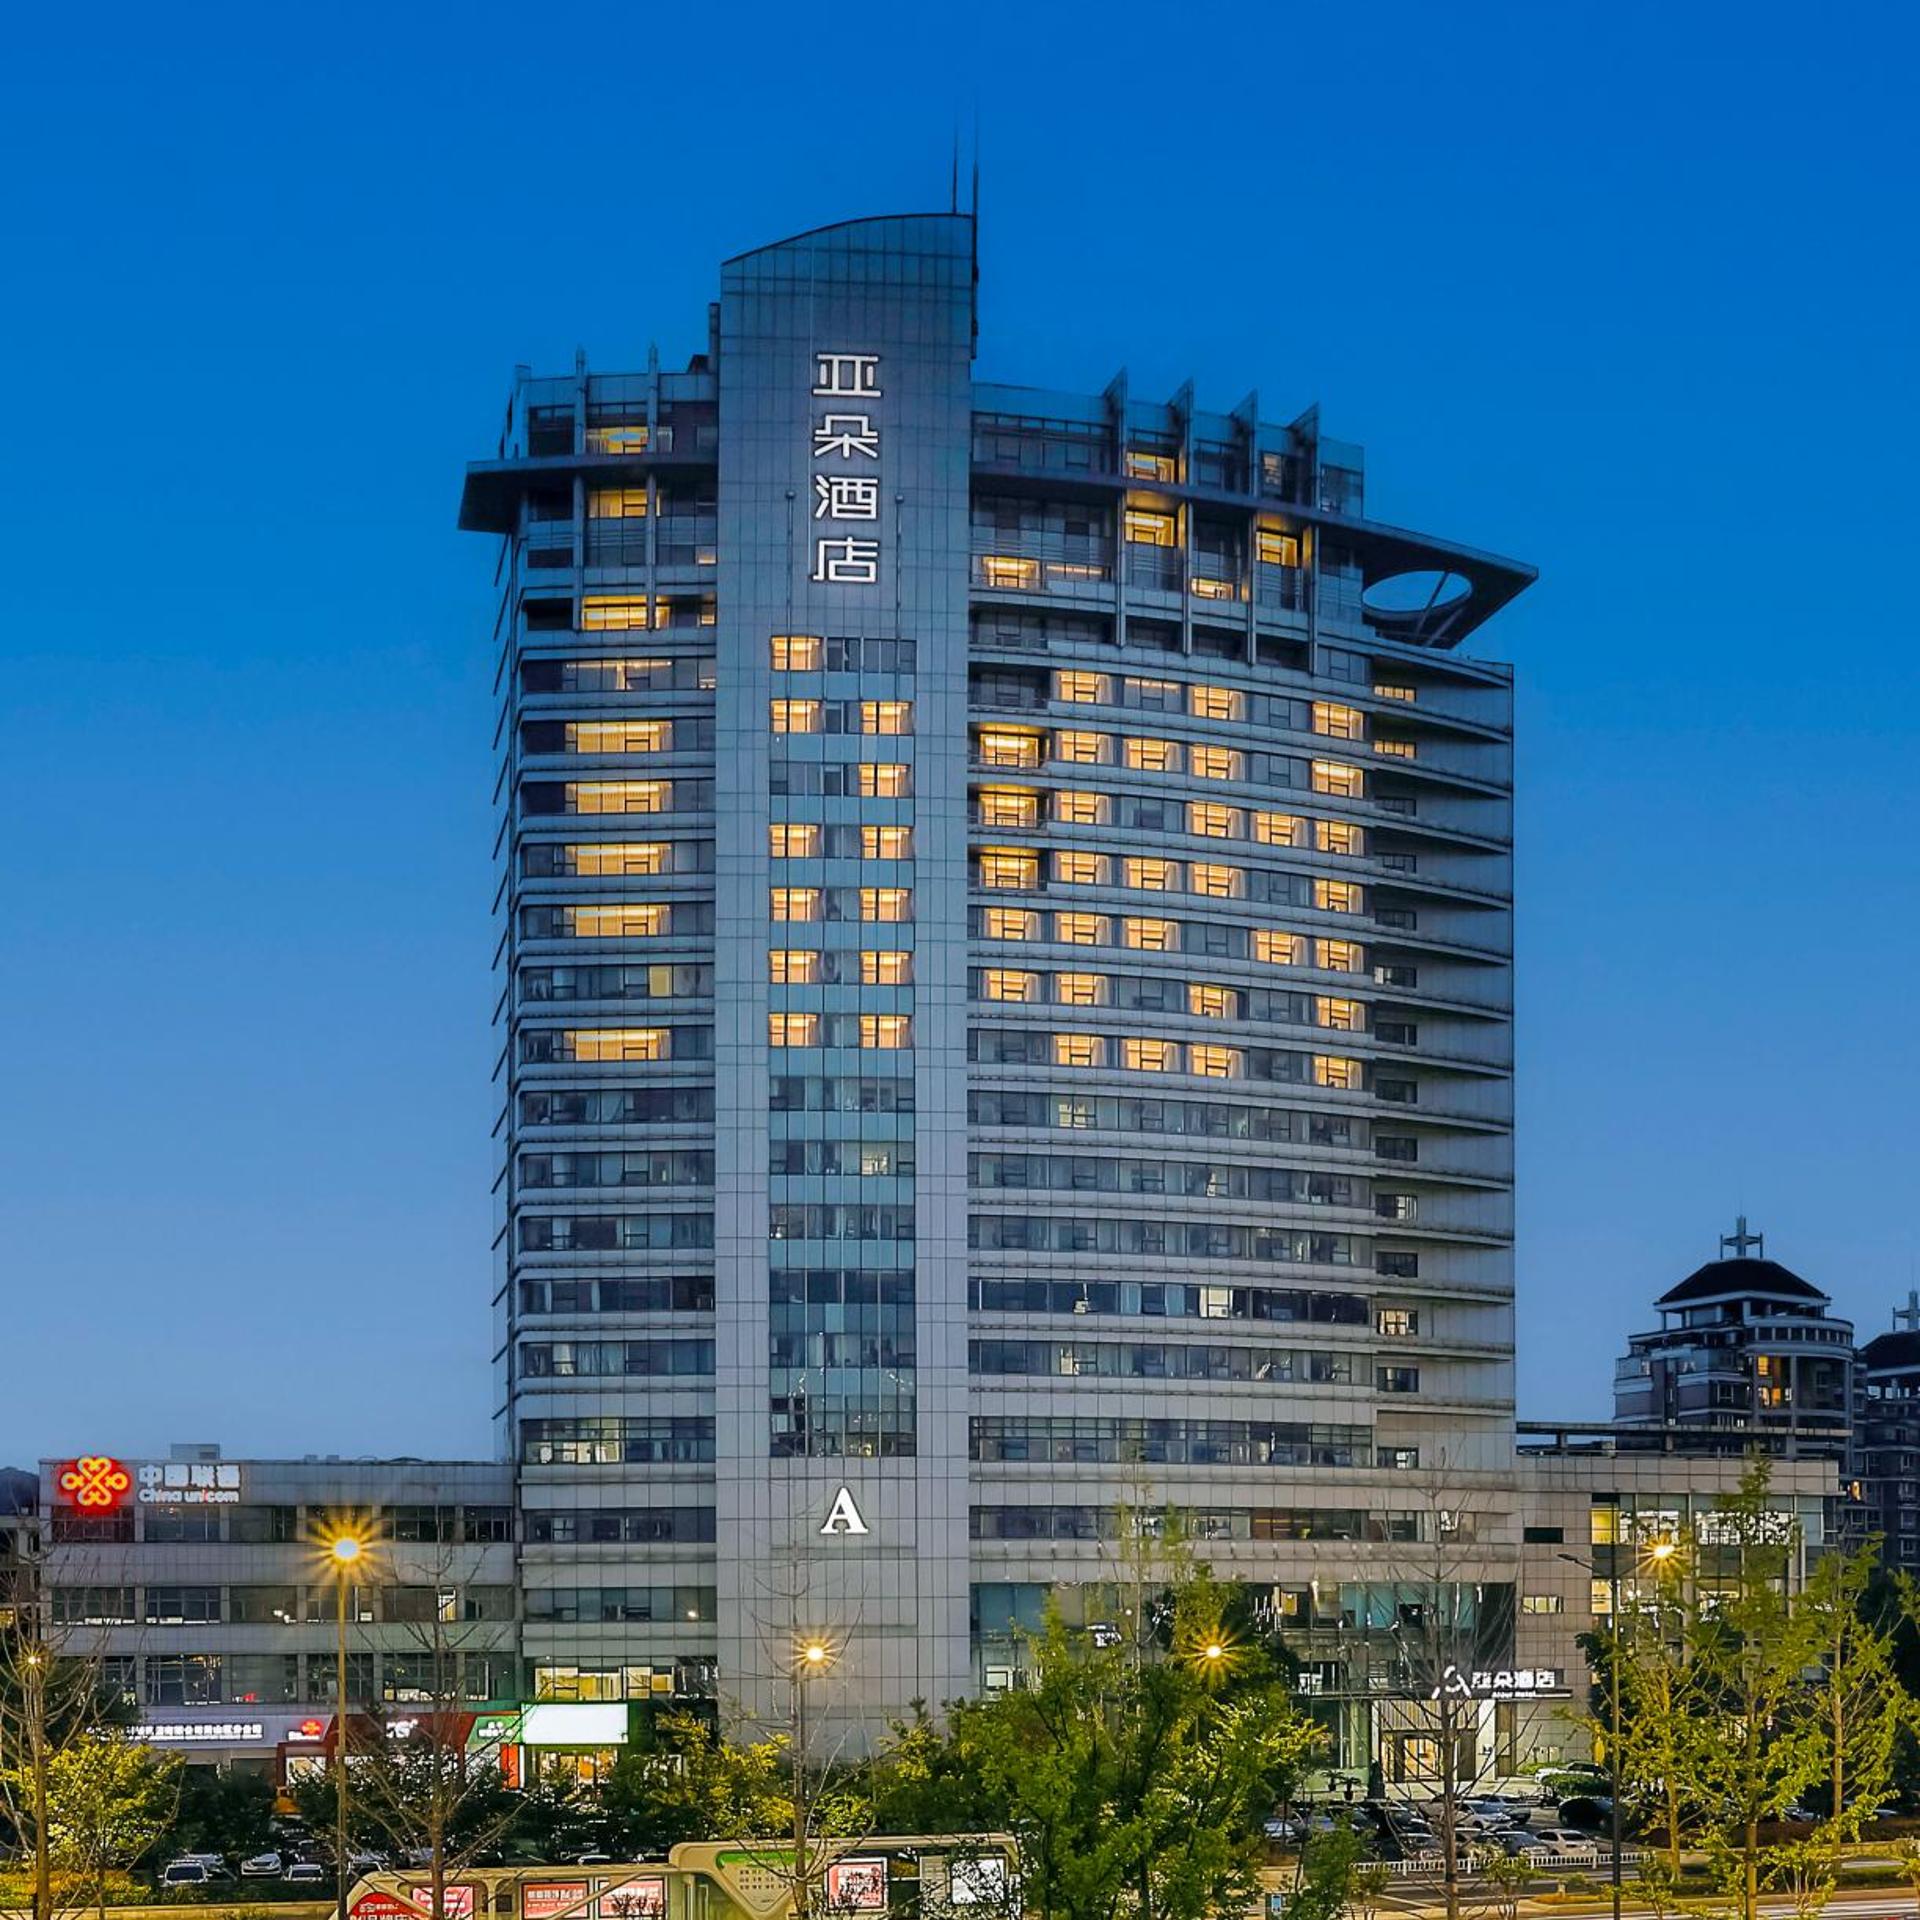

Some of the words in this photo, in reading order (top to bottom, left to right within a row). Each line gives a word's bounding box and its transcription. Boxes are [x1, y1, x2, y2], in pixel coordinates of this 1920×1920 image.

[812, 353, 882, 583] 亚朵酒店
[820, 1487, 869, 1534] A
[1471, 1669, 1555, 1689] 亚朵酒店
